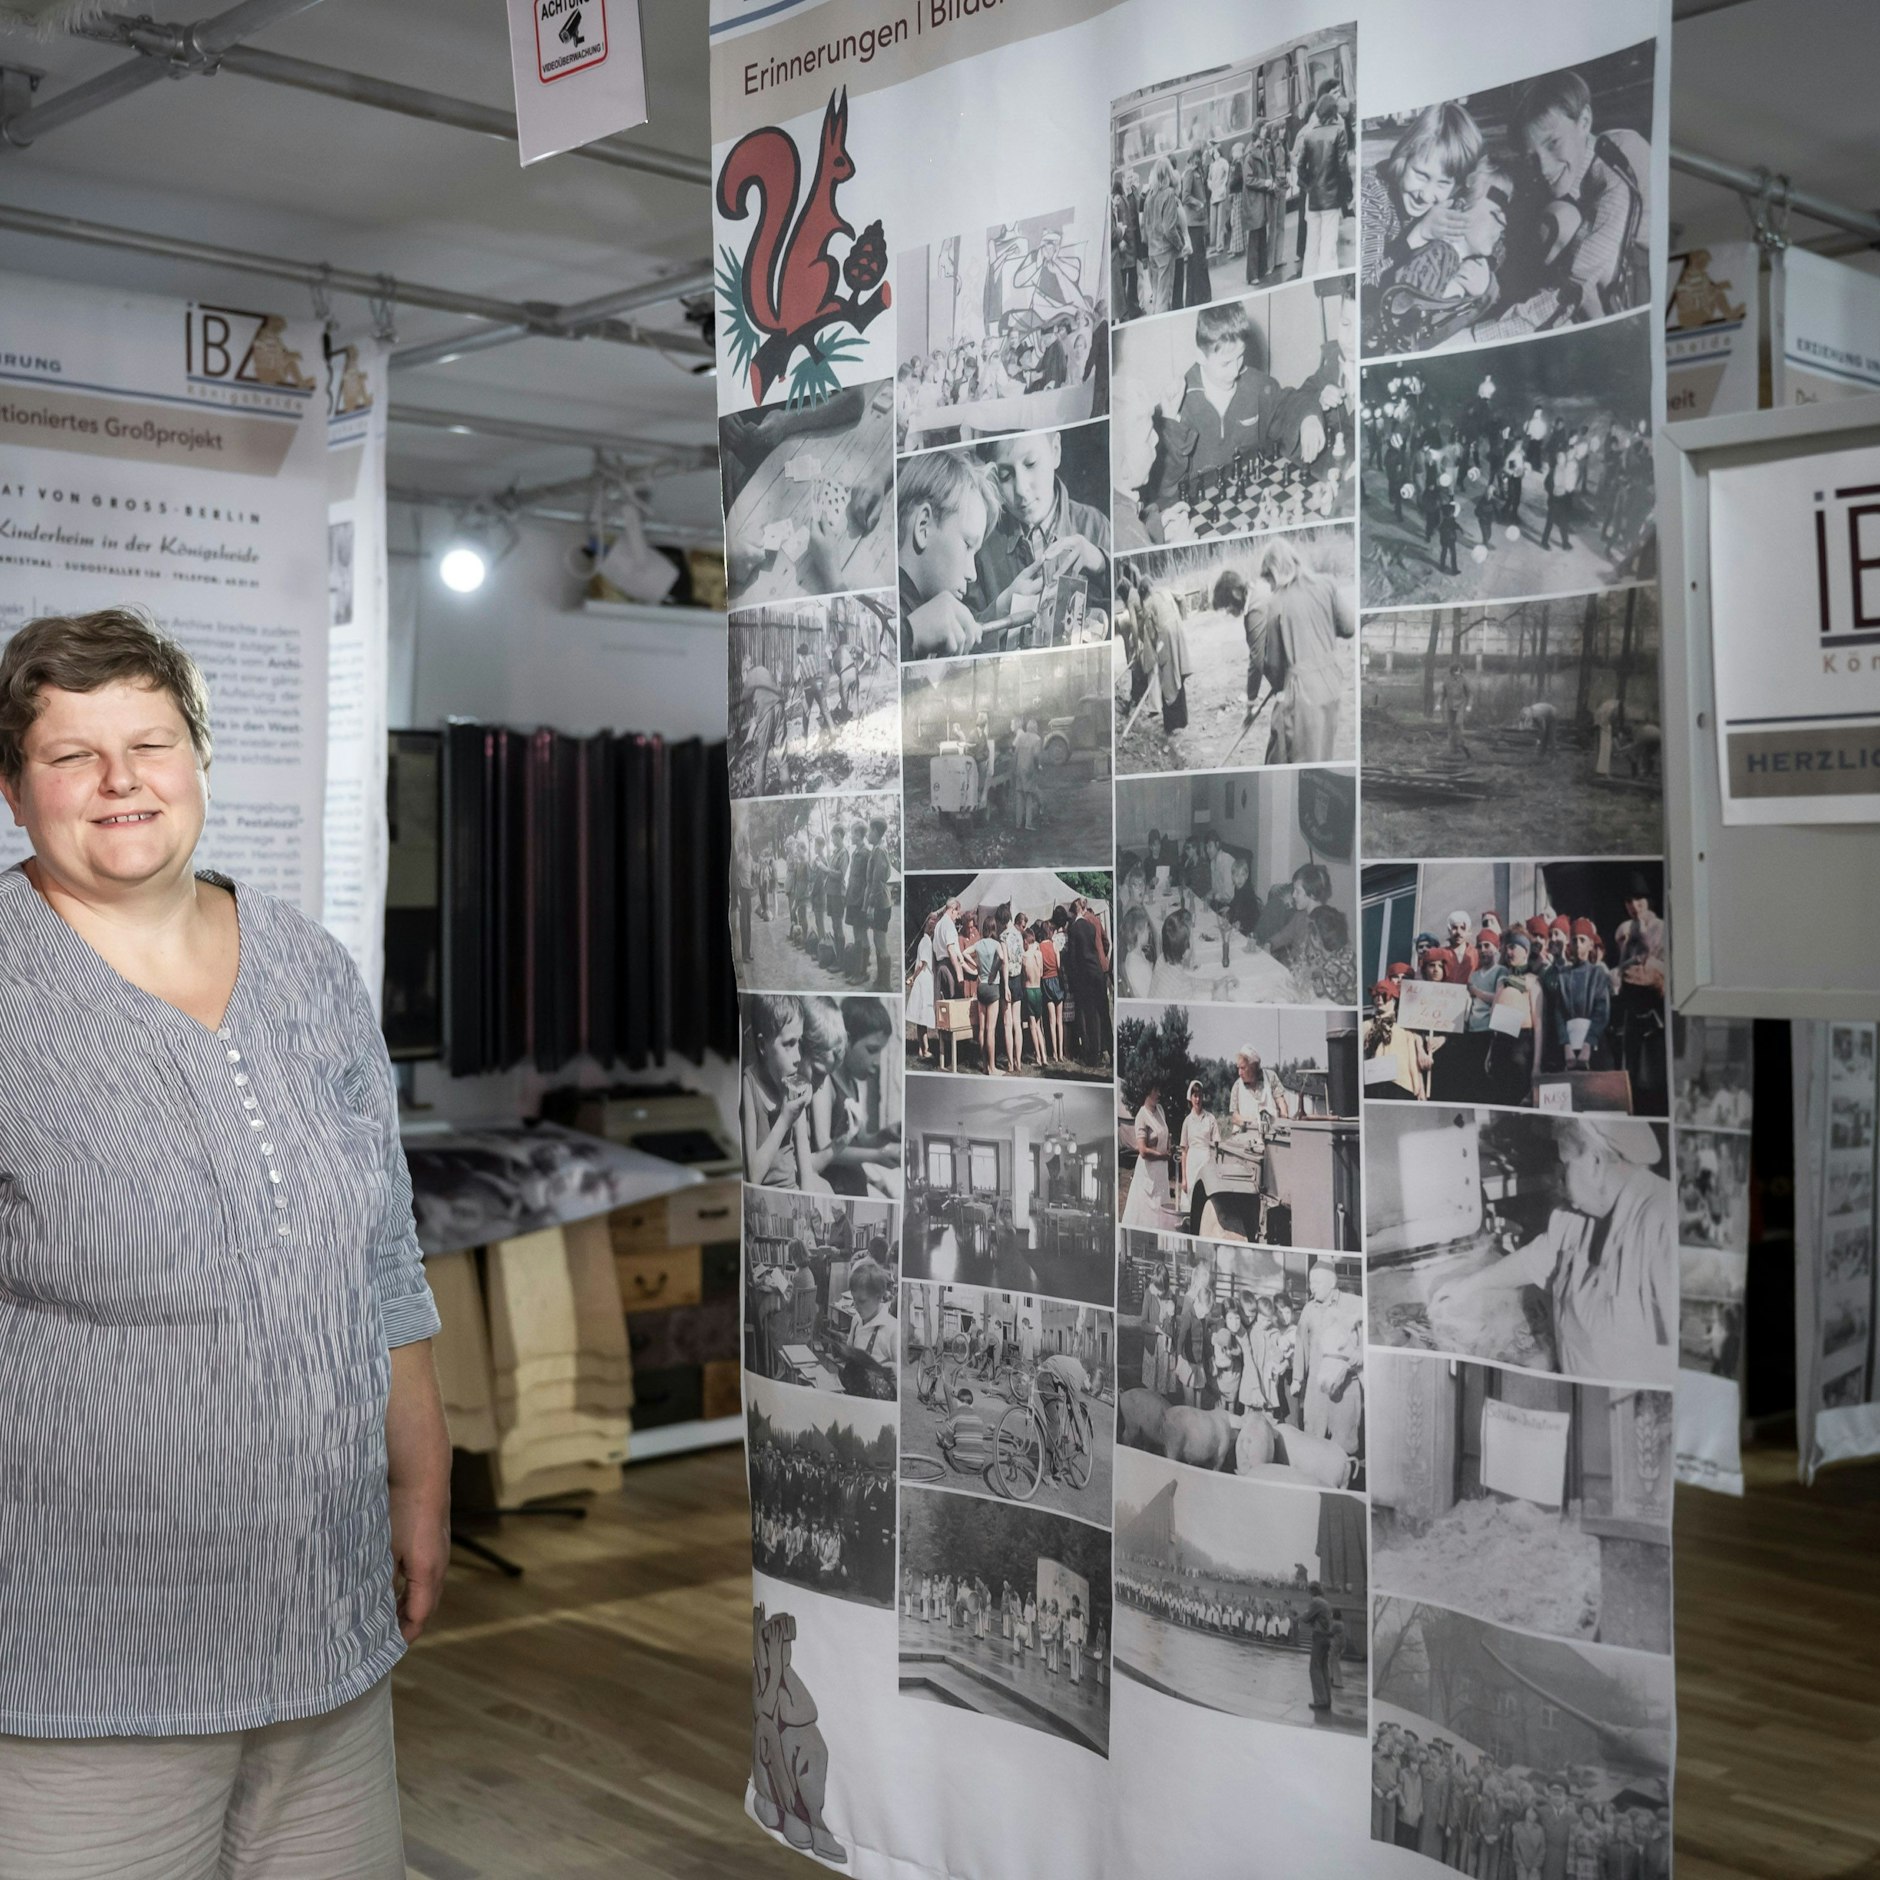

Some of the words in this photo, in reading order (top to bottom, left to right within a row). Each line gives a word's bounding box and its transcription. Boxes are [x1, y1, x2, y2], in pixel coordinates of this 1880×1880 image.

[541, 0, 590, 20] ACHTU
[744, 19, 908, 95] Erinnerungen
[931, 0, 1003, 28] Bil
[0, 354, 62, 373] RUNG
[1, 404, 98, 434] tioniertes
[105, 417, 223, 451] Großprojekt
[38, 488, 80, 504] VON
[102, 535, 118, 550] in
[125, 533, 151, 552] der
